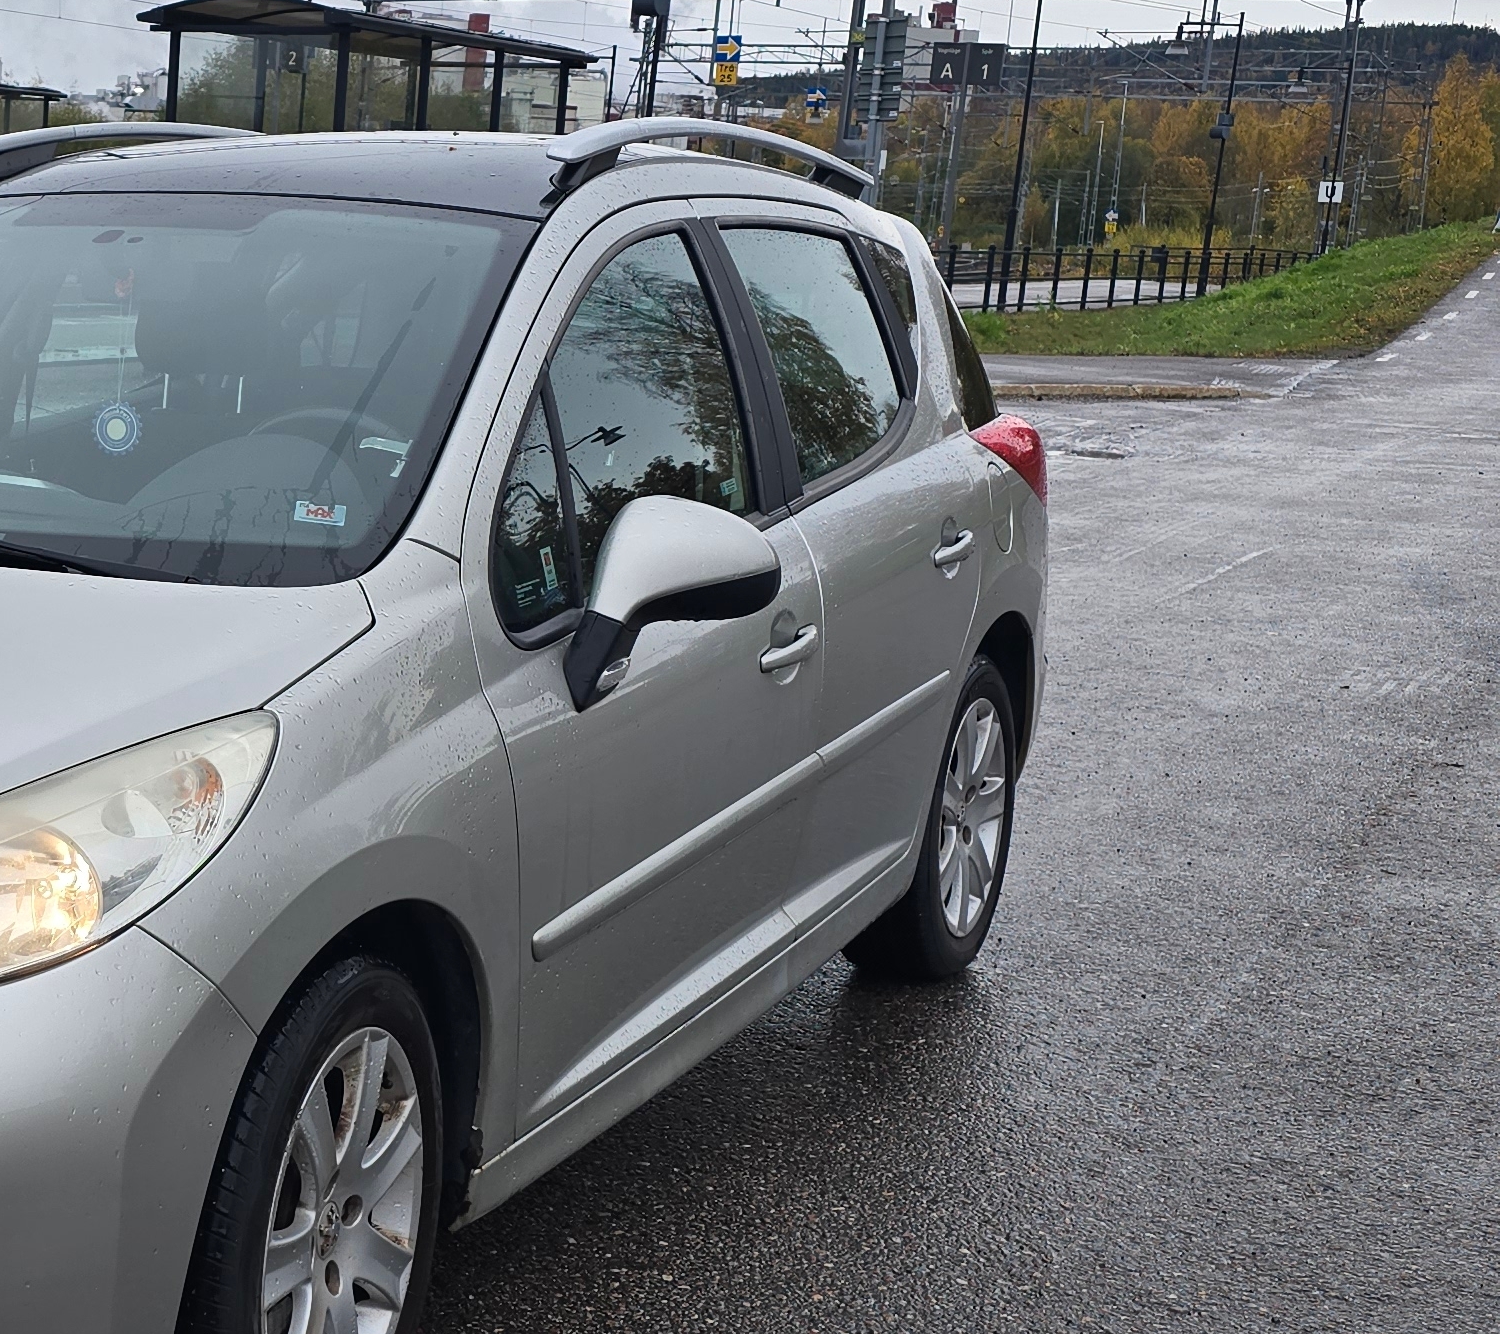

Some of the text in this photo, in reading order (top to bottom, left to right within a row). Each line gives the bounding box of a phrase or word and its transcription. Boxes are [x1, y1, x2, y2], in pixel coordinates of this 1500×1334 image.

[288, 51, 297, 66] 2
[719, 74, 732, 83] 25
[940, 62, 953, 79] A
[981, 63, 989, 80] 1
